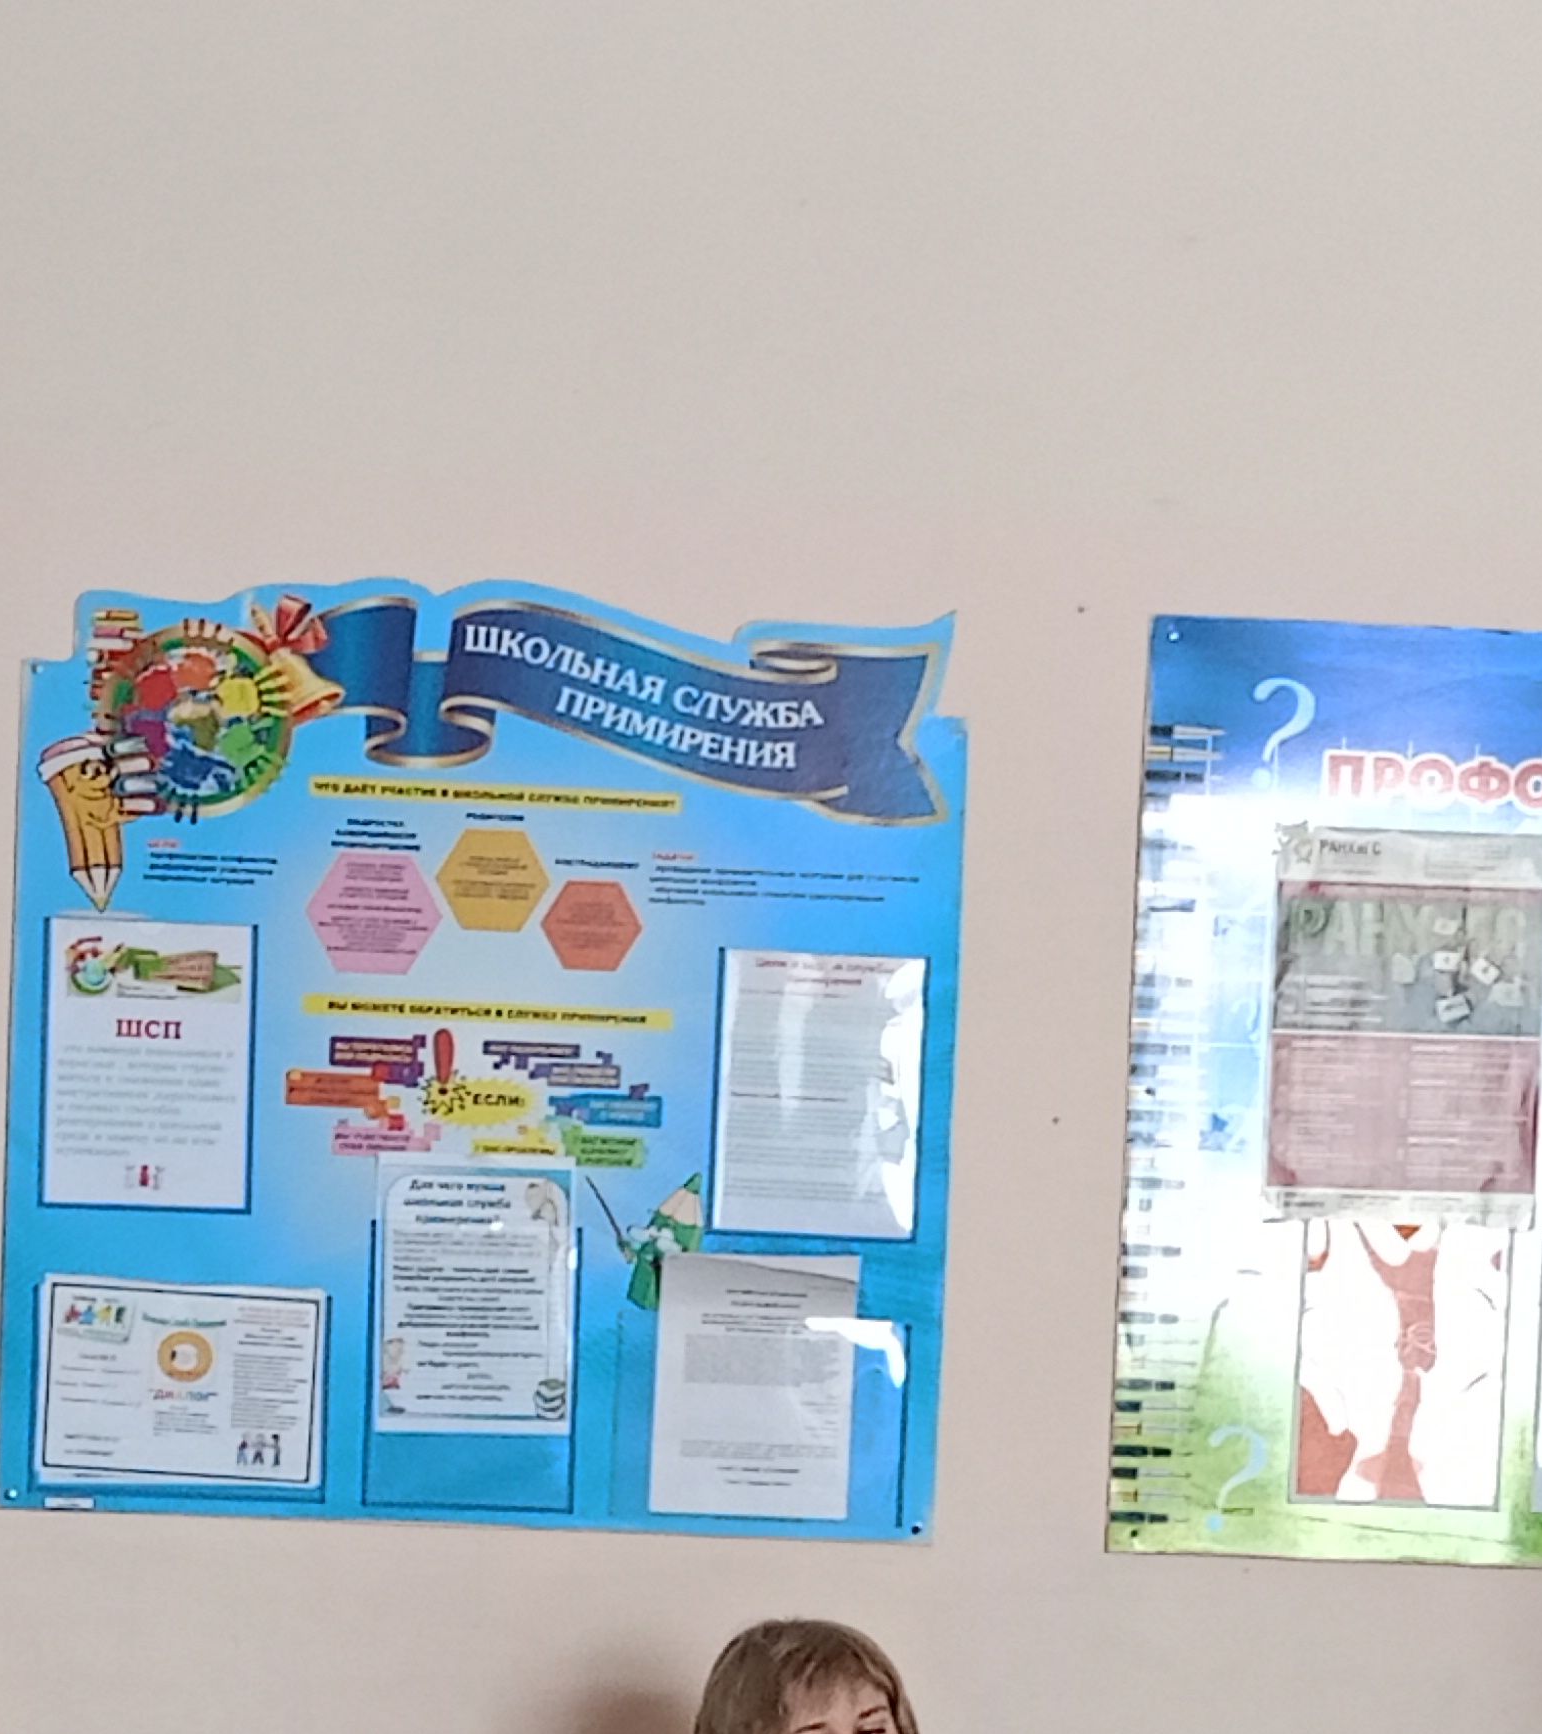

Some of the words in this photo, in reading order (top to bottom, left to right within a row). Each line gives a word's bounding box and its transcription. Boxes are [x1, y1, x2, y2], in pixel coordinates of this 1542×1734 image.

[463, 623, 667, 705] ШКОЛЬНАЯ
[672, 684, 825, 730] СЛУЖБА
[556, 686, 797, 770] ПРИМИРЕНИЯ
[115, 1018, 183, 1040] ШСП
